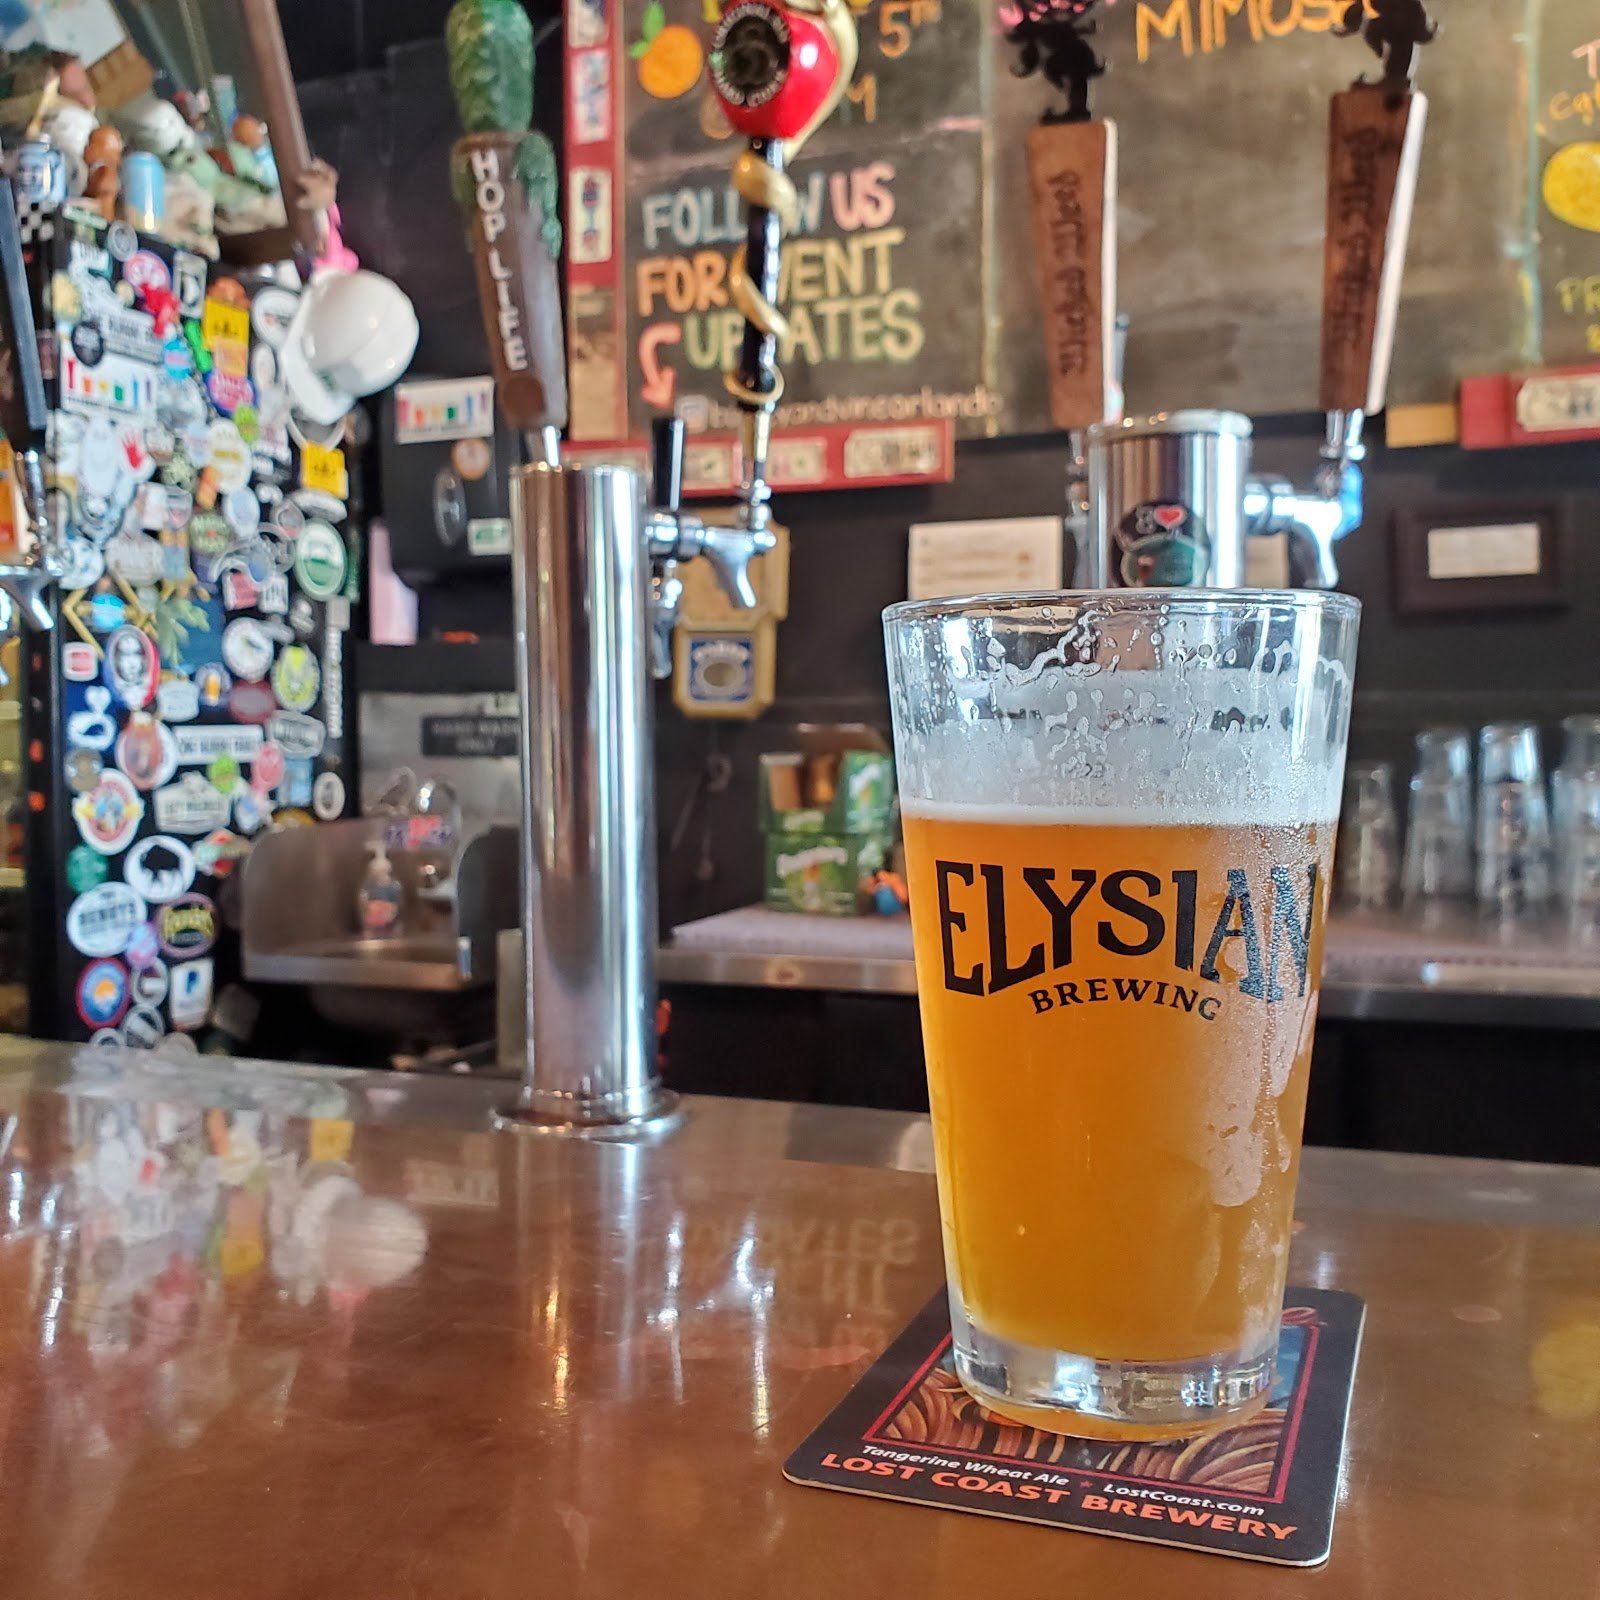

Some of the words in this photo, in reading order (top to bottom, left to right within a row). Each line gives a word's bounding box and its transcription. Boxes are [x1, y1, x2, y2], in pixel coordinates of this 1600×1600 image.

[470, 148, 506, 244] HOP
[640, 170, 828, 250] FOLLW
[829, 160, 898, 232] US
[487, 246, 529, 372] LIFE
[635, 249, 730, 318] FOR
[774, 225, 907, 305] VENT
[683, 286, 926, 372] UPATES
[934, 859, 1318, 1004] ELYSIAN
[1027, 977, 1223, 1022] BREWING
[819, 1452, 925, 1481] LOST
[930, 1471, 1072, 1505] COAST
[1080, 1493, 1299, 1541] BREWERY
[861, 1444, 961, 1470] Tangerine
[964, 1460, 1032, 1481] Wheat
[1033, 1472, 1070, 1487] Ale
[1102, 1482, 1265, 1517] LostCoast.com
